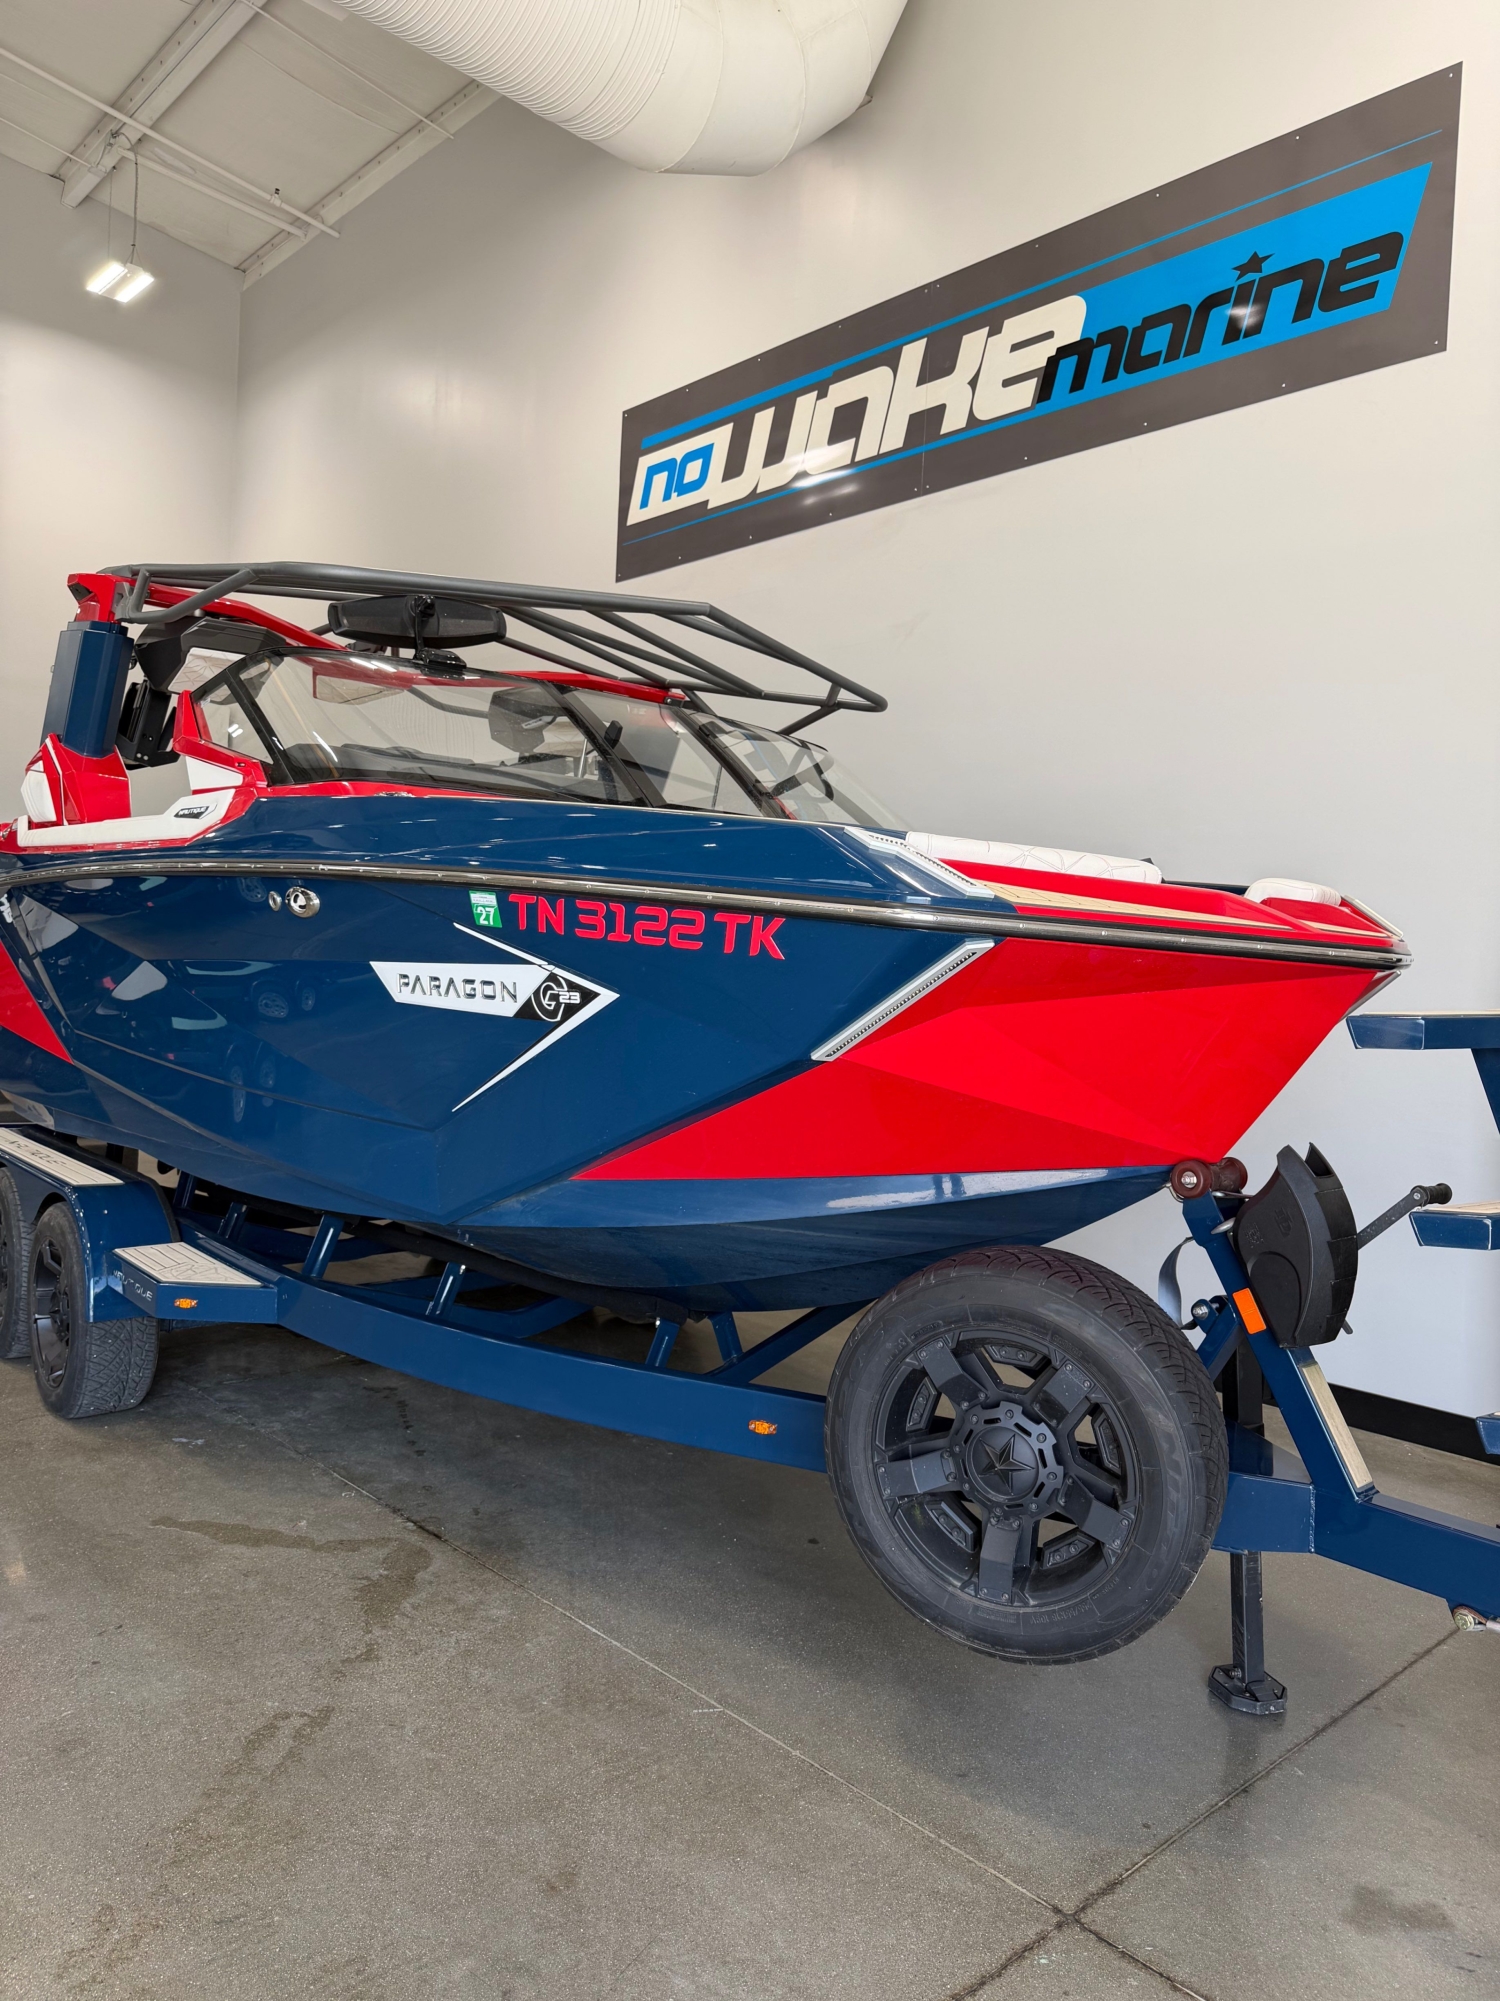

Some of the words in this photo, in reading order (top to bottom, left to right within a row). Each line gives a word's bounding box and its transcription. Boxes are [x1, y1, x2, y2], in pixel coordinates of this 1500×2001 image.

[639, 442, 715, 511] no
[1036, 231, 1404, 405] marine
[476, 906, 496, 926] 27
[508, 893, 565, 936] TN
[574, 899, 706, 950] 3122
[713, 912, 786, 960] TK
[396, 973, 518, 1004] PARAGON
